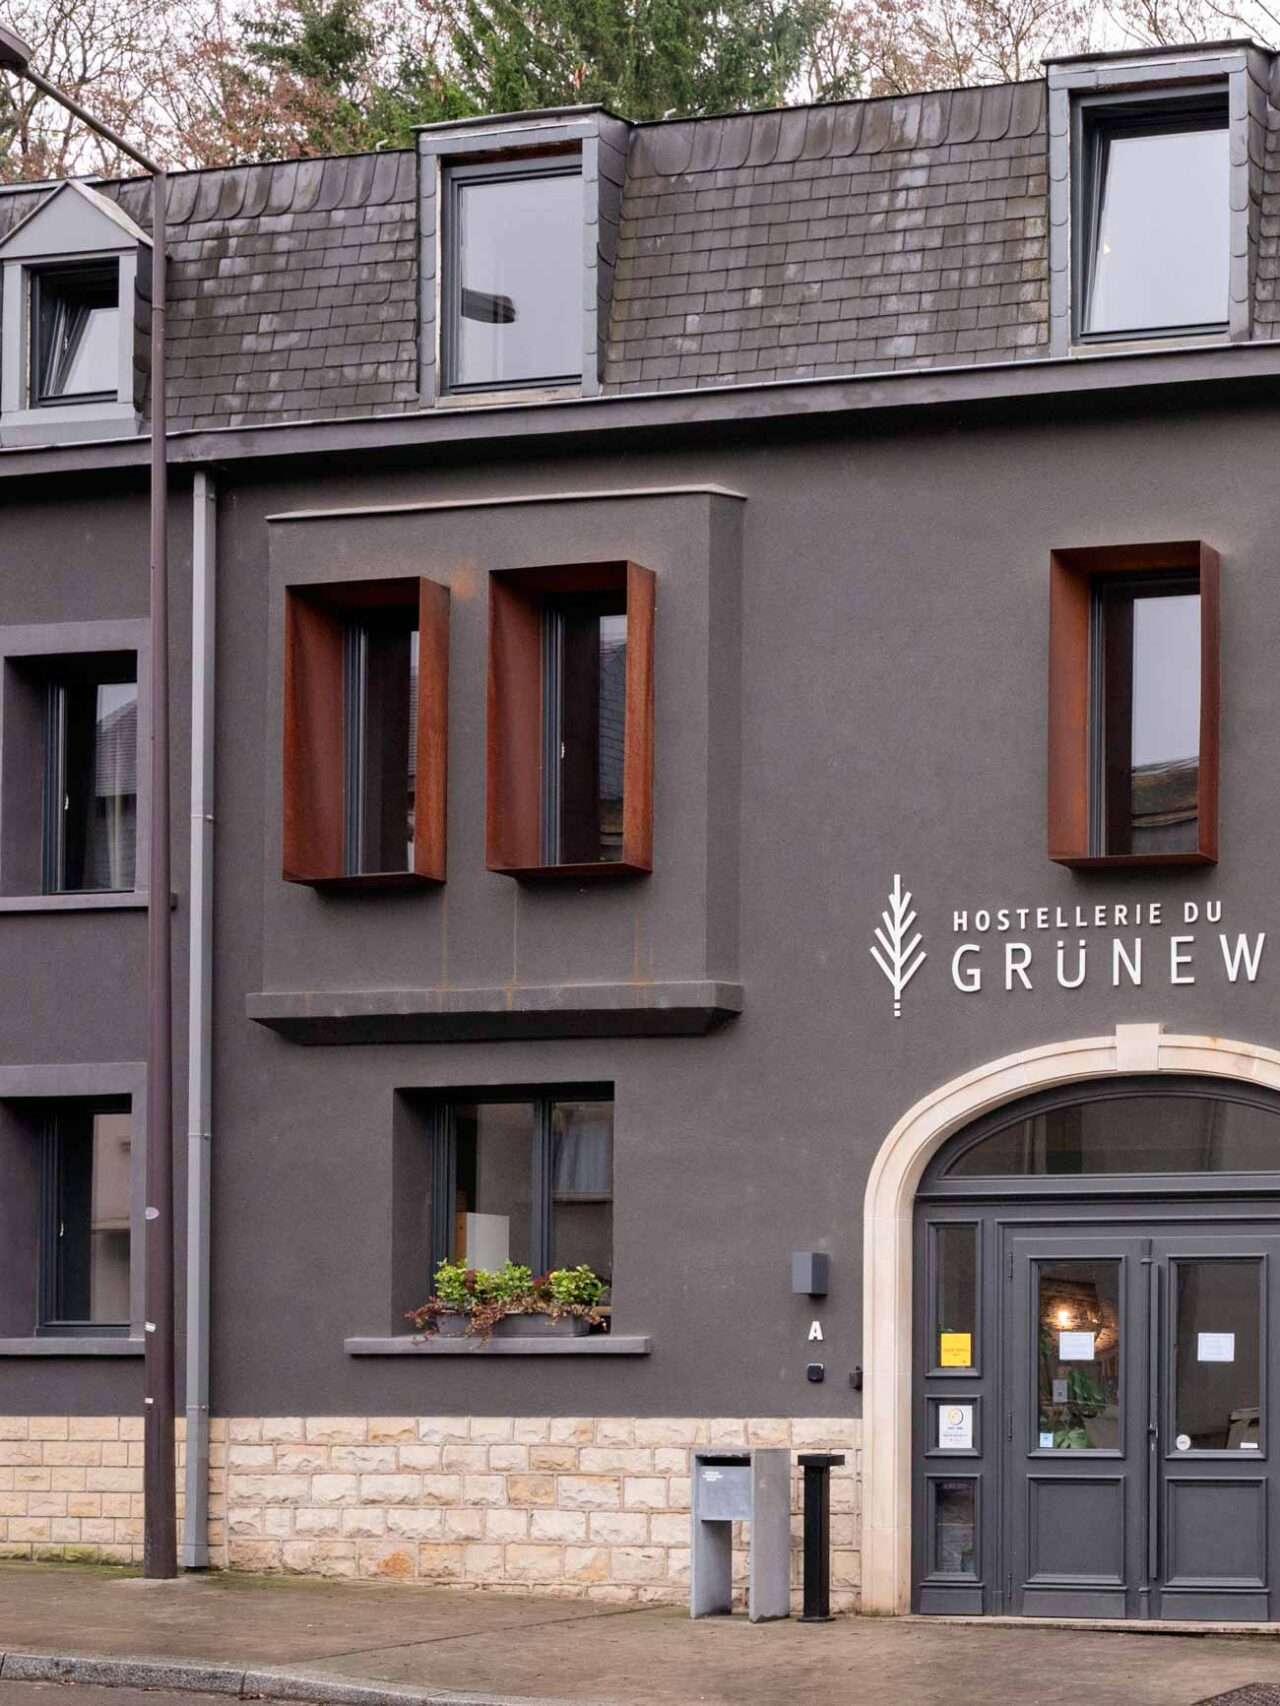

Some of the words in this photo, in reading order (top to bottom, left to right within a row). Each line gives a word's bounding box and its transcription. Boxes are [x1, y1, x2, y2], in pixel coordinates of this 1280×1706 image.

[953, 903, 1162, 932] HOSTELLERIE
[1183, 900, 1222, 923] DU
[807, 1320, 824, 1341] A
